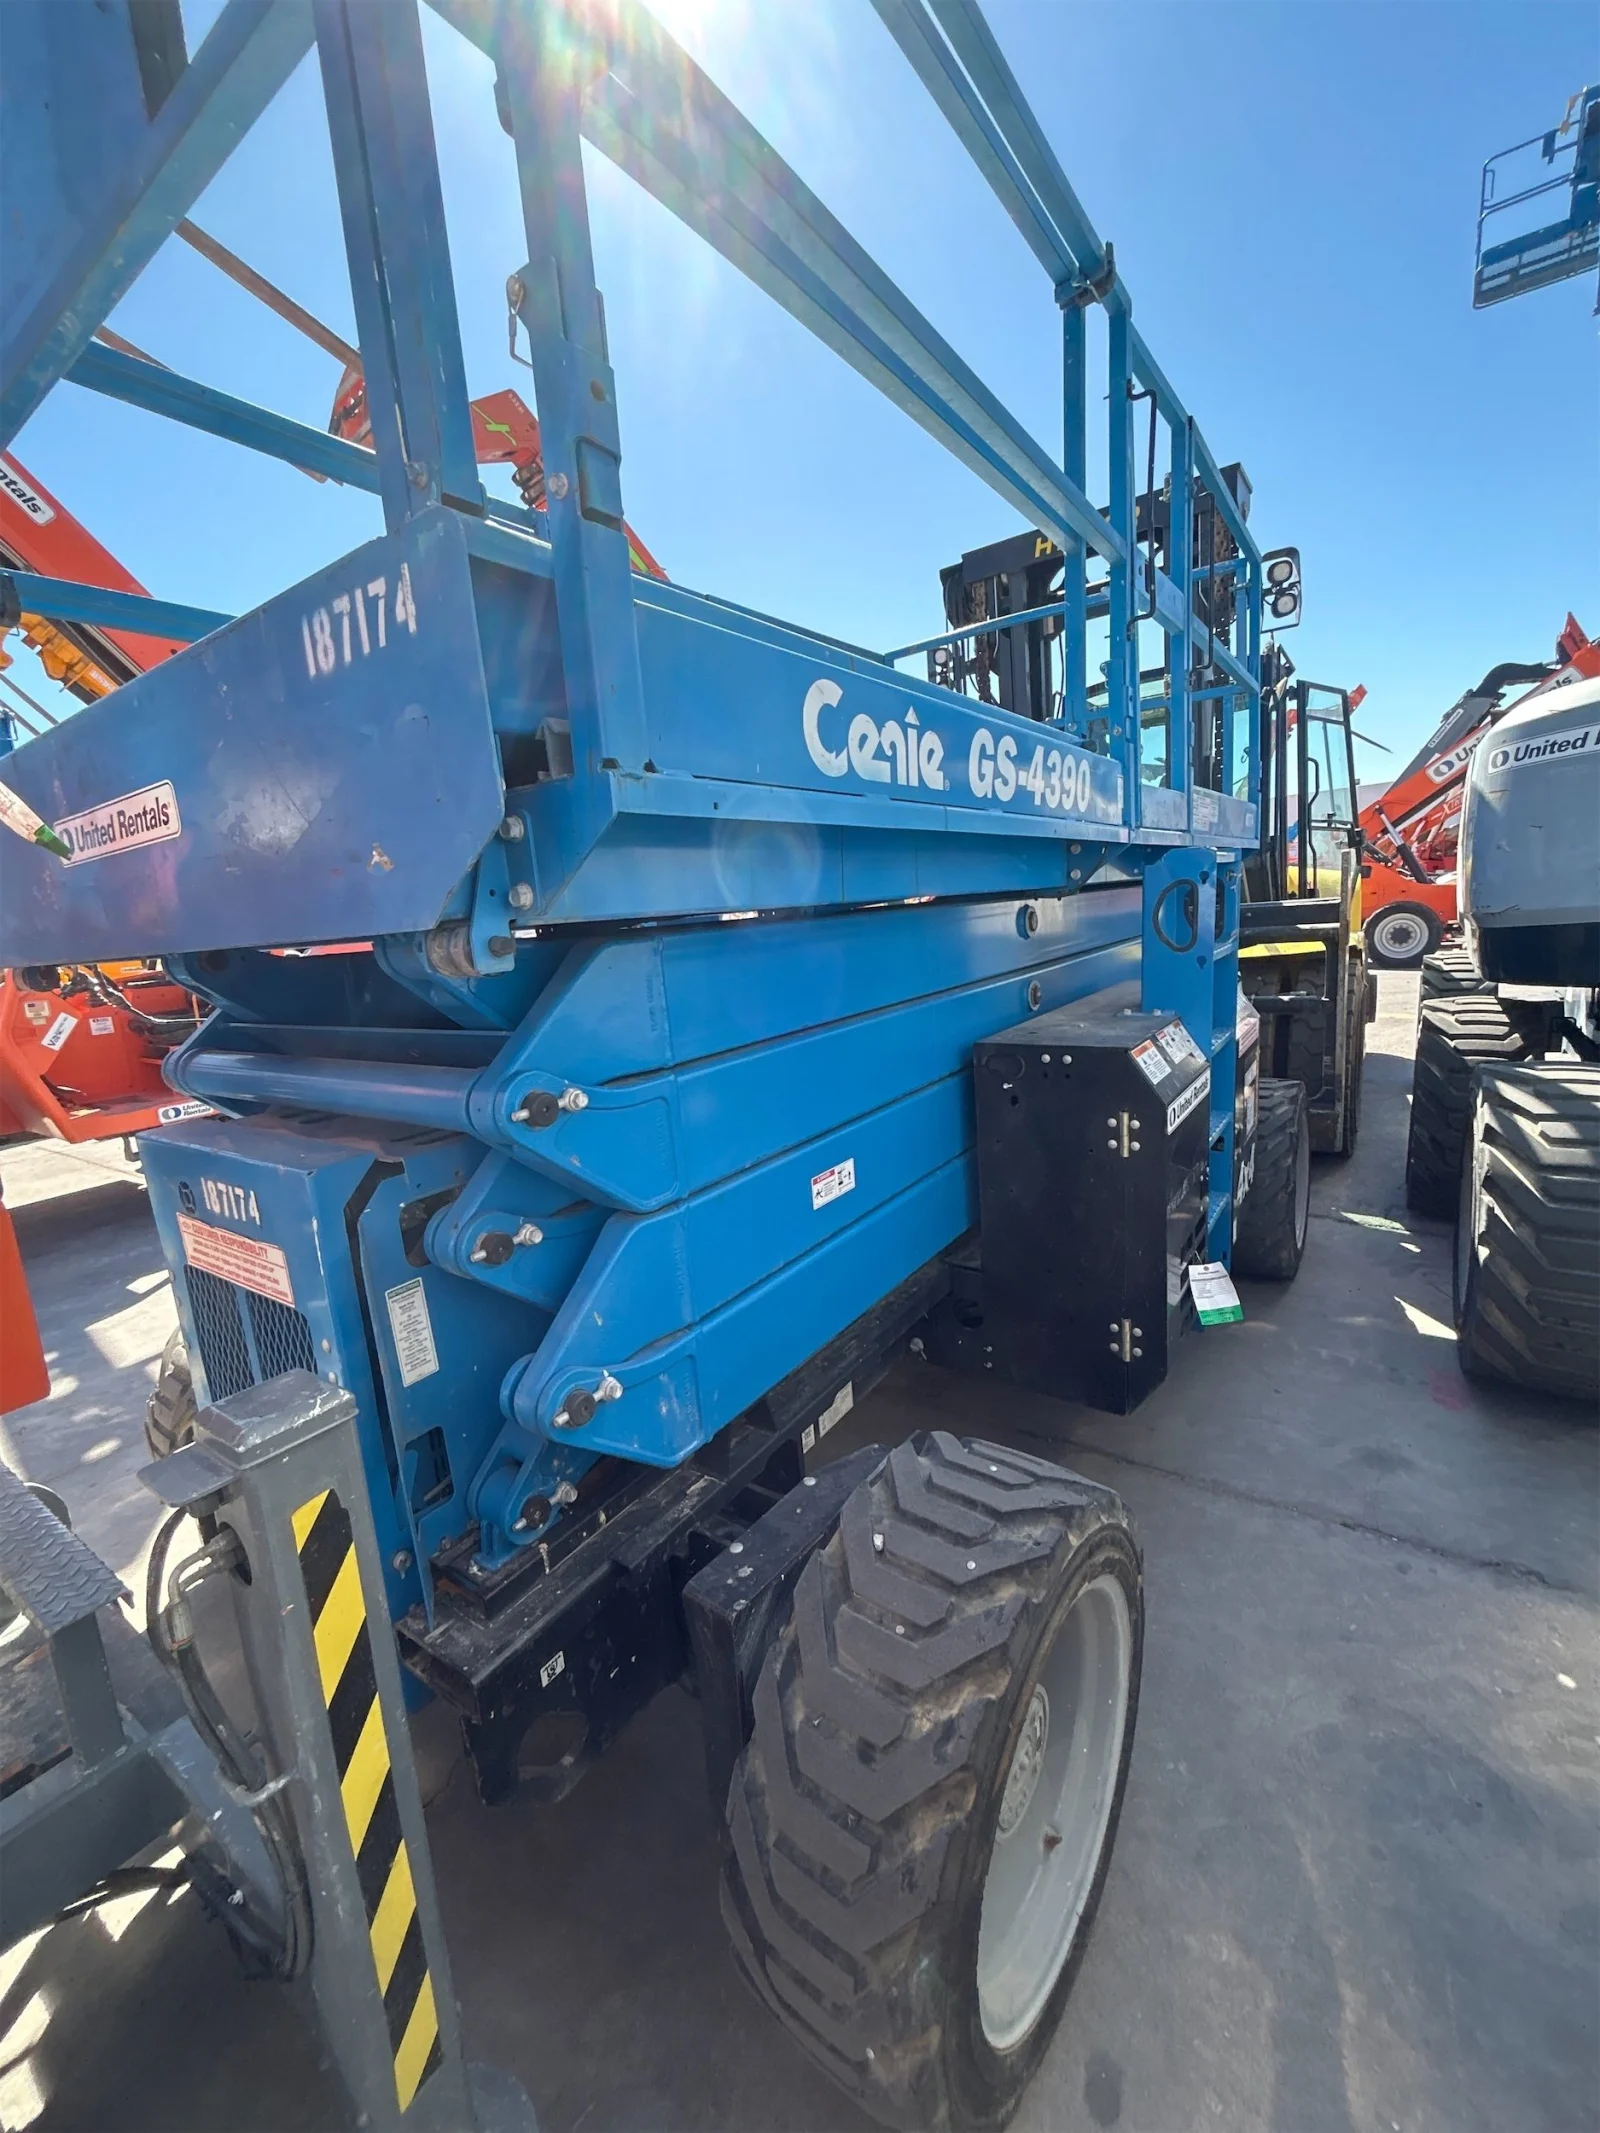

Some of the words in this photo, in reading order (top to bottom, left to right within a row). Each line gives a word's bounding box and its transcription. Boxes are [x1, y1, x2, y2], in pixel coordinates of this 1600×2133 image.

[302, 563, 417, 677] 187174
[803, 679, 944, 790] Genie
[969, 728, 1090, 812] GS-4390
[1513, 731, 1590, 762] United
[75, 814, 117, 852] United
[117, 797, 170, 839] Rentals
[182, 1103, 206, 1111] Unite
[183, 1107, 211, 1116] Rentals
[1177, 1089, 1194, 1119] United
[201, 1177, 261, 1225] 187174
